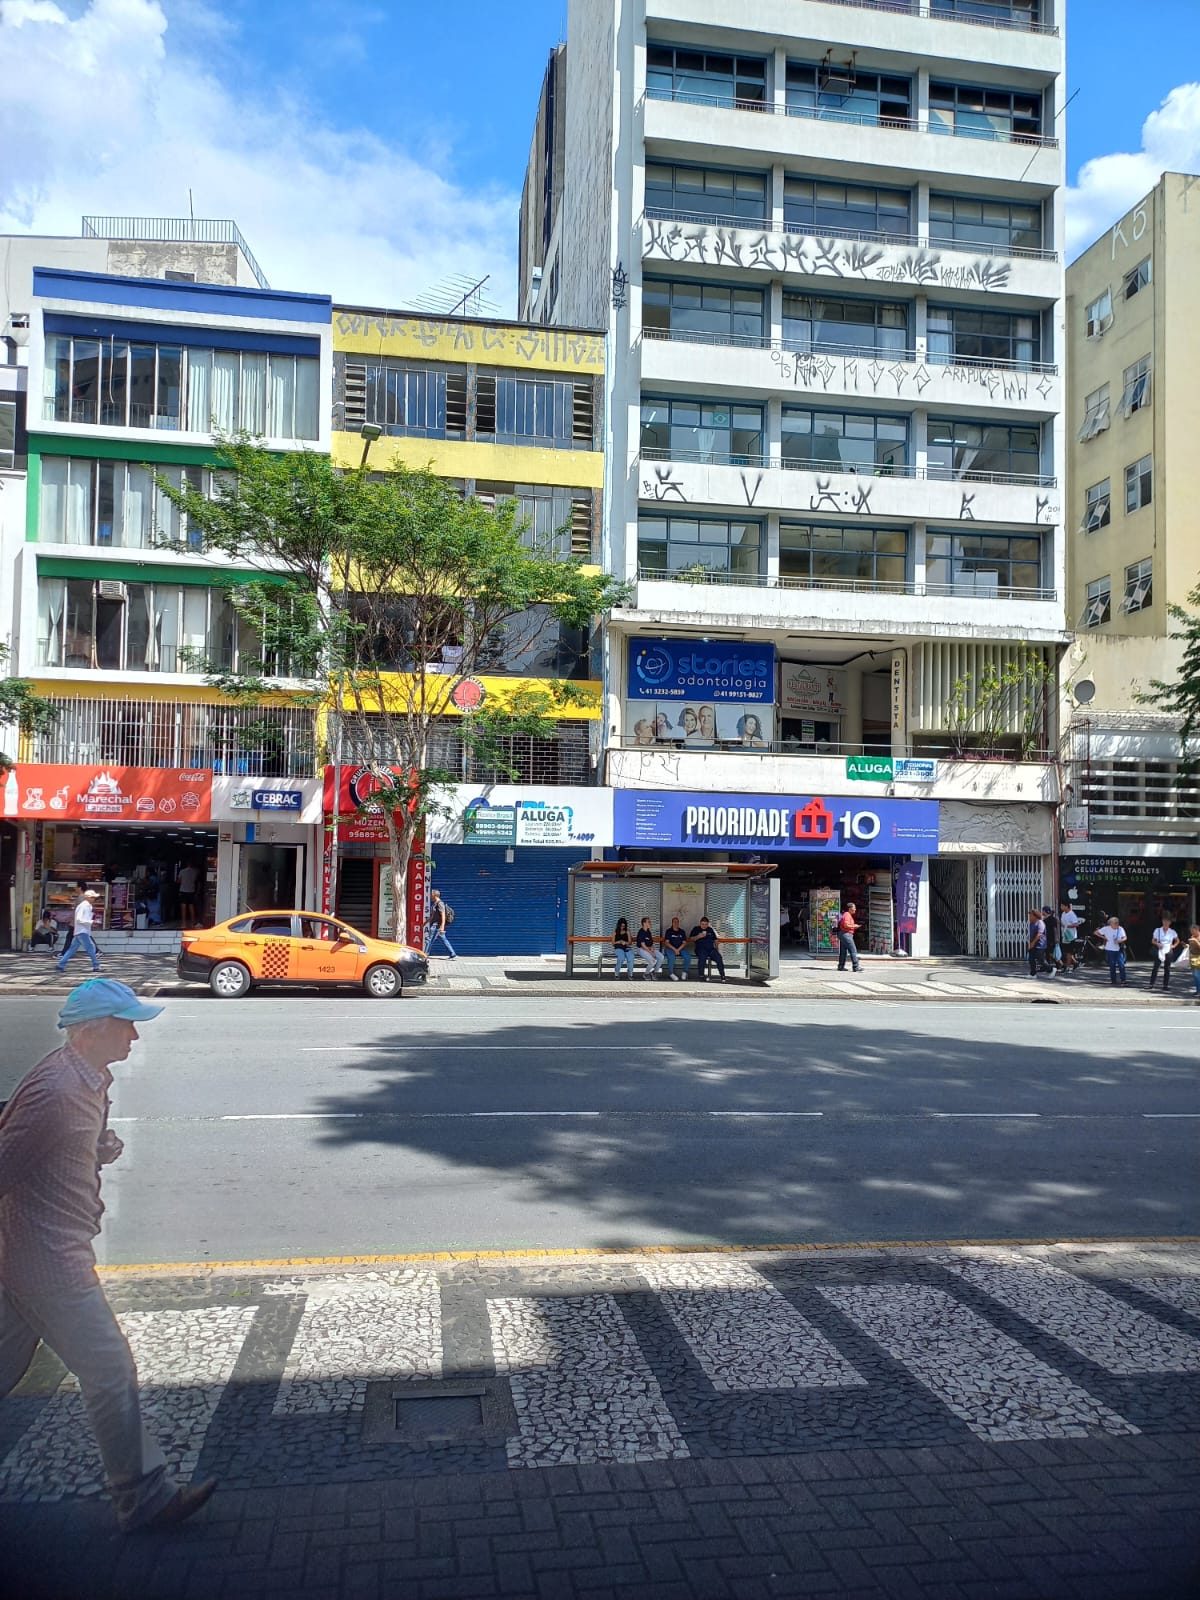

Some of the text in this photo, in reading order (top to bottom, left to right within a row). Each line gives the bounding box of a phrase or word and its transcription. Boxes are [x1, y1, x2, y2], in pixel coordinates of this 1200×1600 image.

[678, 653, 768, 677] stories
[677, 676, 767, 690] odontologia
[893, 660, 901, 729] DENTISTA
[848, 763, 893, 774] ALUGA
[76, 794, 133, 804] Marechal
[255, 792, 299, 805] CEBRAC
[520, 810, 565, 822] ALUGA
[686, 806, 790, 838] PRIORIDADE
[839, 810, 881, 840] 10
[1074, 857, 1123, 866] ACESSÓRIOS
[412, 861, 424, 944] CAPOEIRA
